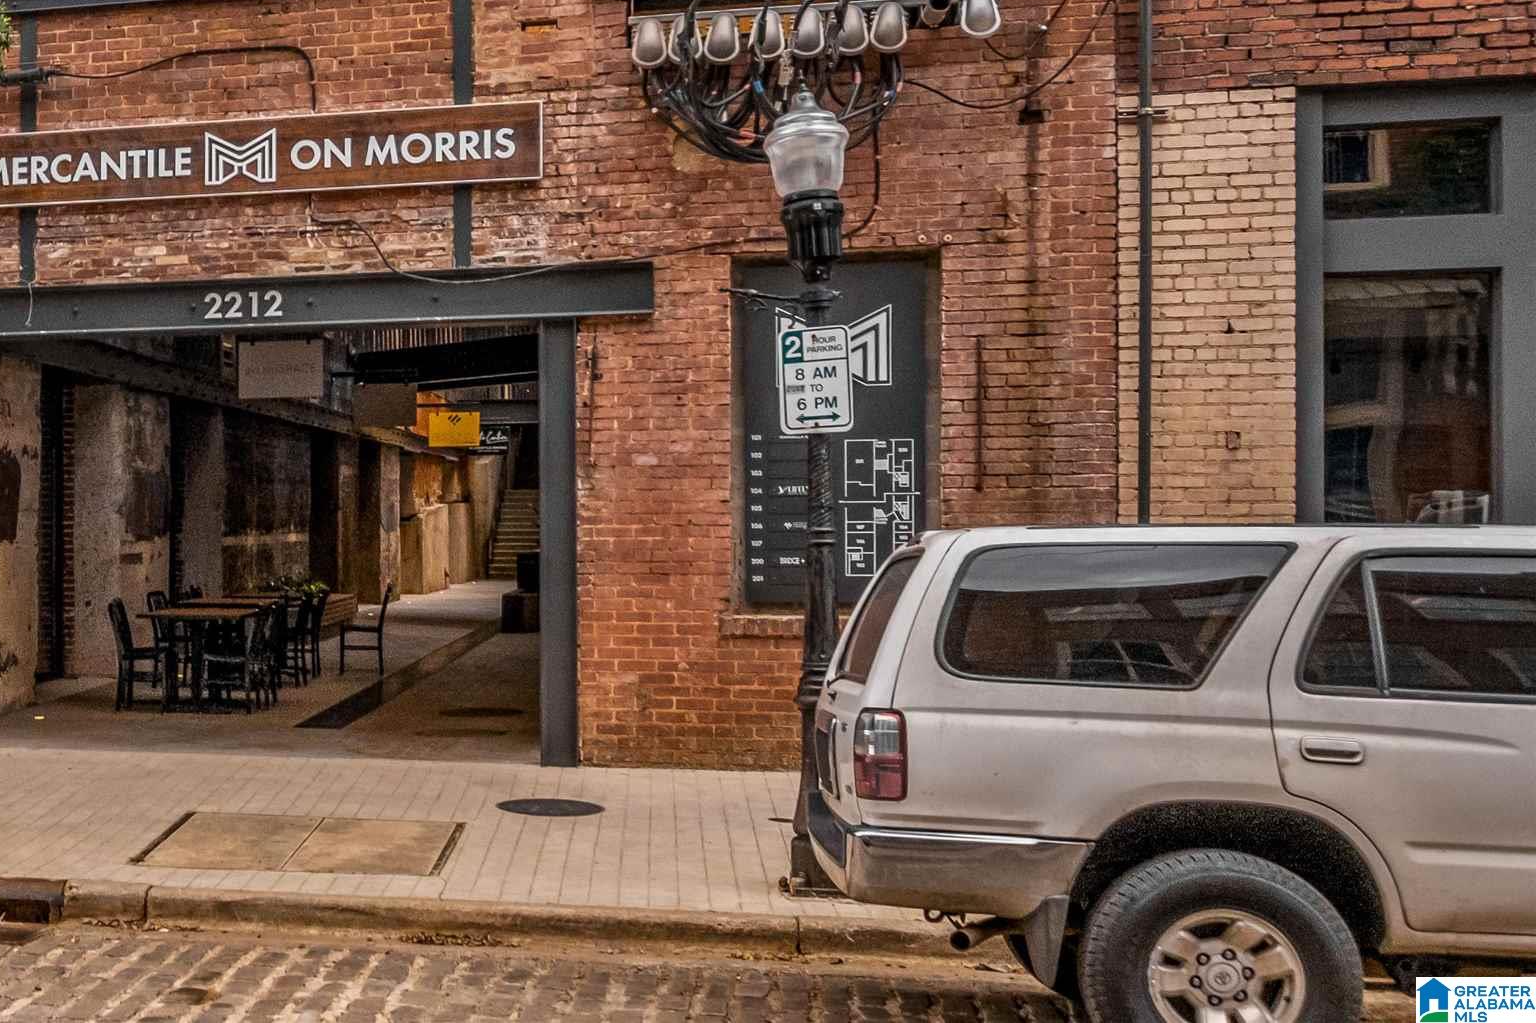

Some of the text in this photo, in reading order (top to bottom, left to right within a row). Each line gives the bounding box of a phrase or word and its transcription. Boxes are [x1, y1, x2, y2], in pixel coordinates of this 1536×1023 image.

[290, 137, 353, 171] ON
[364, 127, 517, 167] MORRIS
[203, 290, 284, 320] 2212
[784, 335, 802, 358] 2
[806, 343, 843, 353] PARKING
[795, 366, 837, 381] 8 AM
[809, 383, 824, 392] TO
[797, 396, 838, 411] 6 PM
